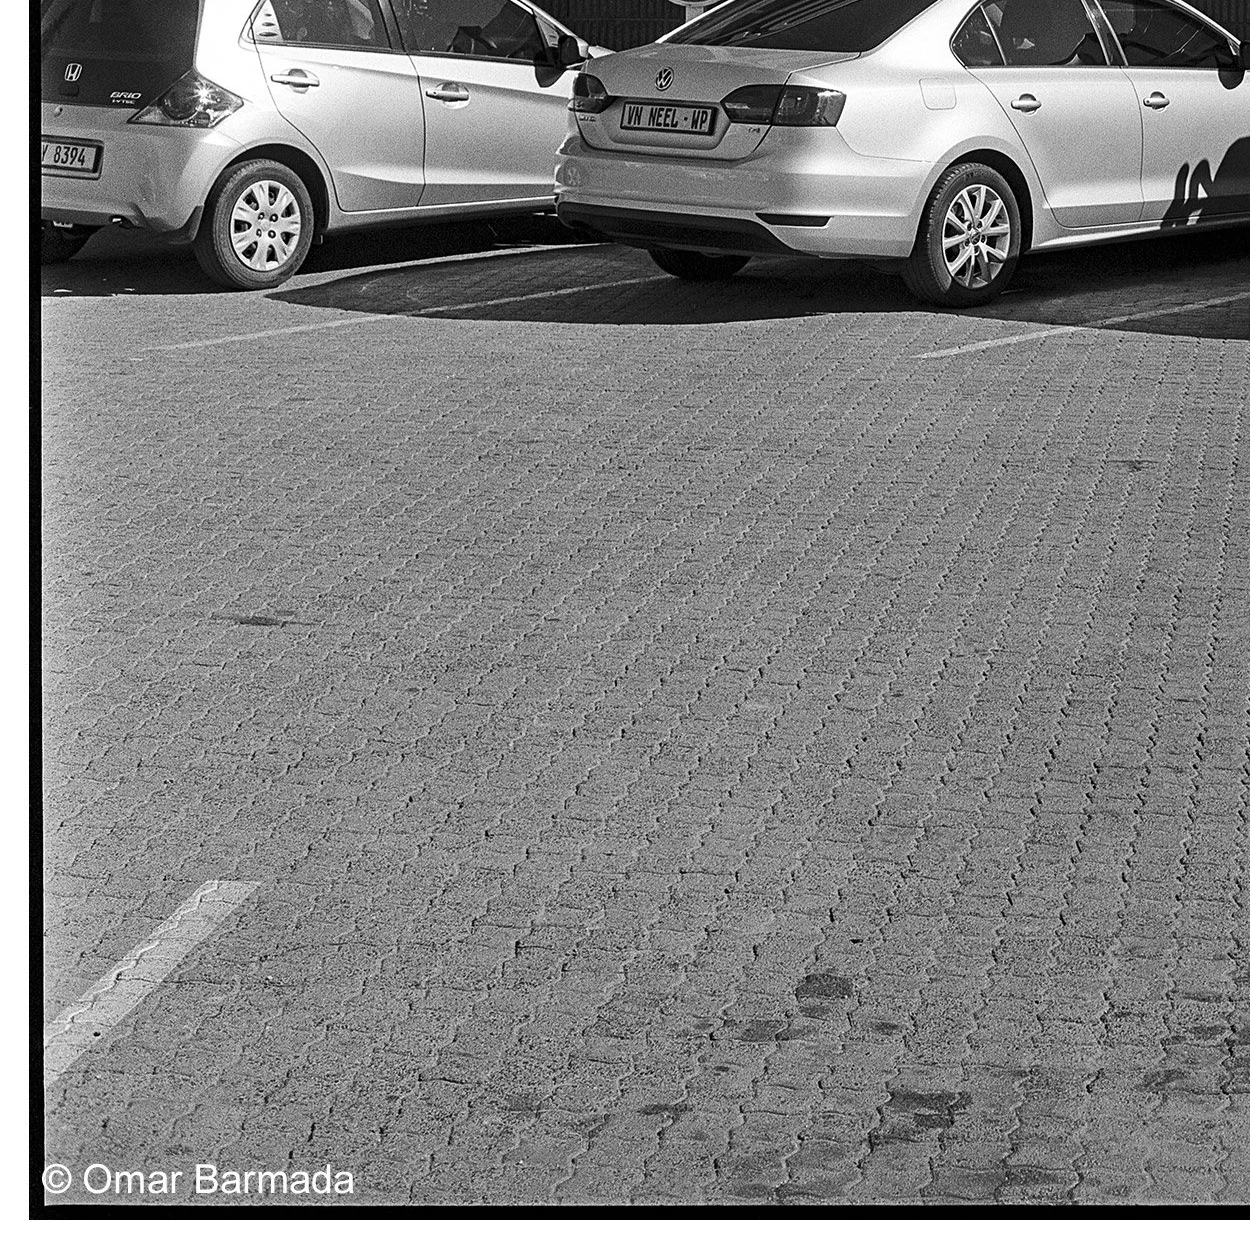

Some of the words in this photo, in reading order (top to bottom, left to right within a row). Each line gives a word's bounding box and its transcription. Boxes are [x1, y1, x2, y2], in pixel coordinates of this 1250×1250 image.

[110, 91, 142, 100] BRIO
[627, 105, 644, 126] VN
[648, 107, 679, 128] NEEL
[691, 110, 708, 130] WP
[53, 145, 85, 166] 8394
